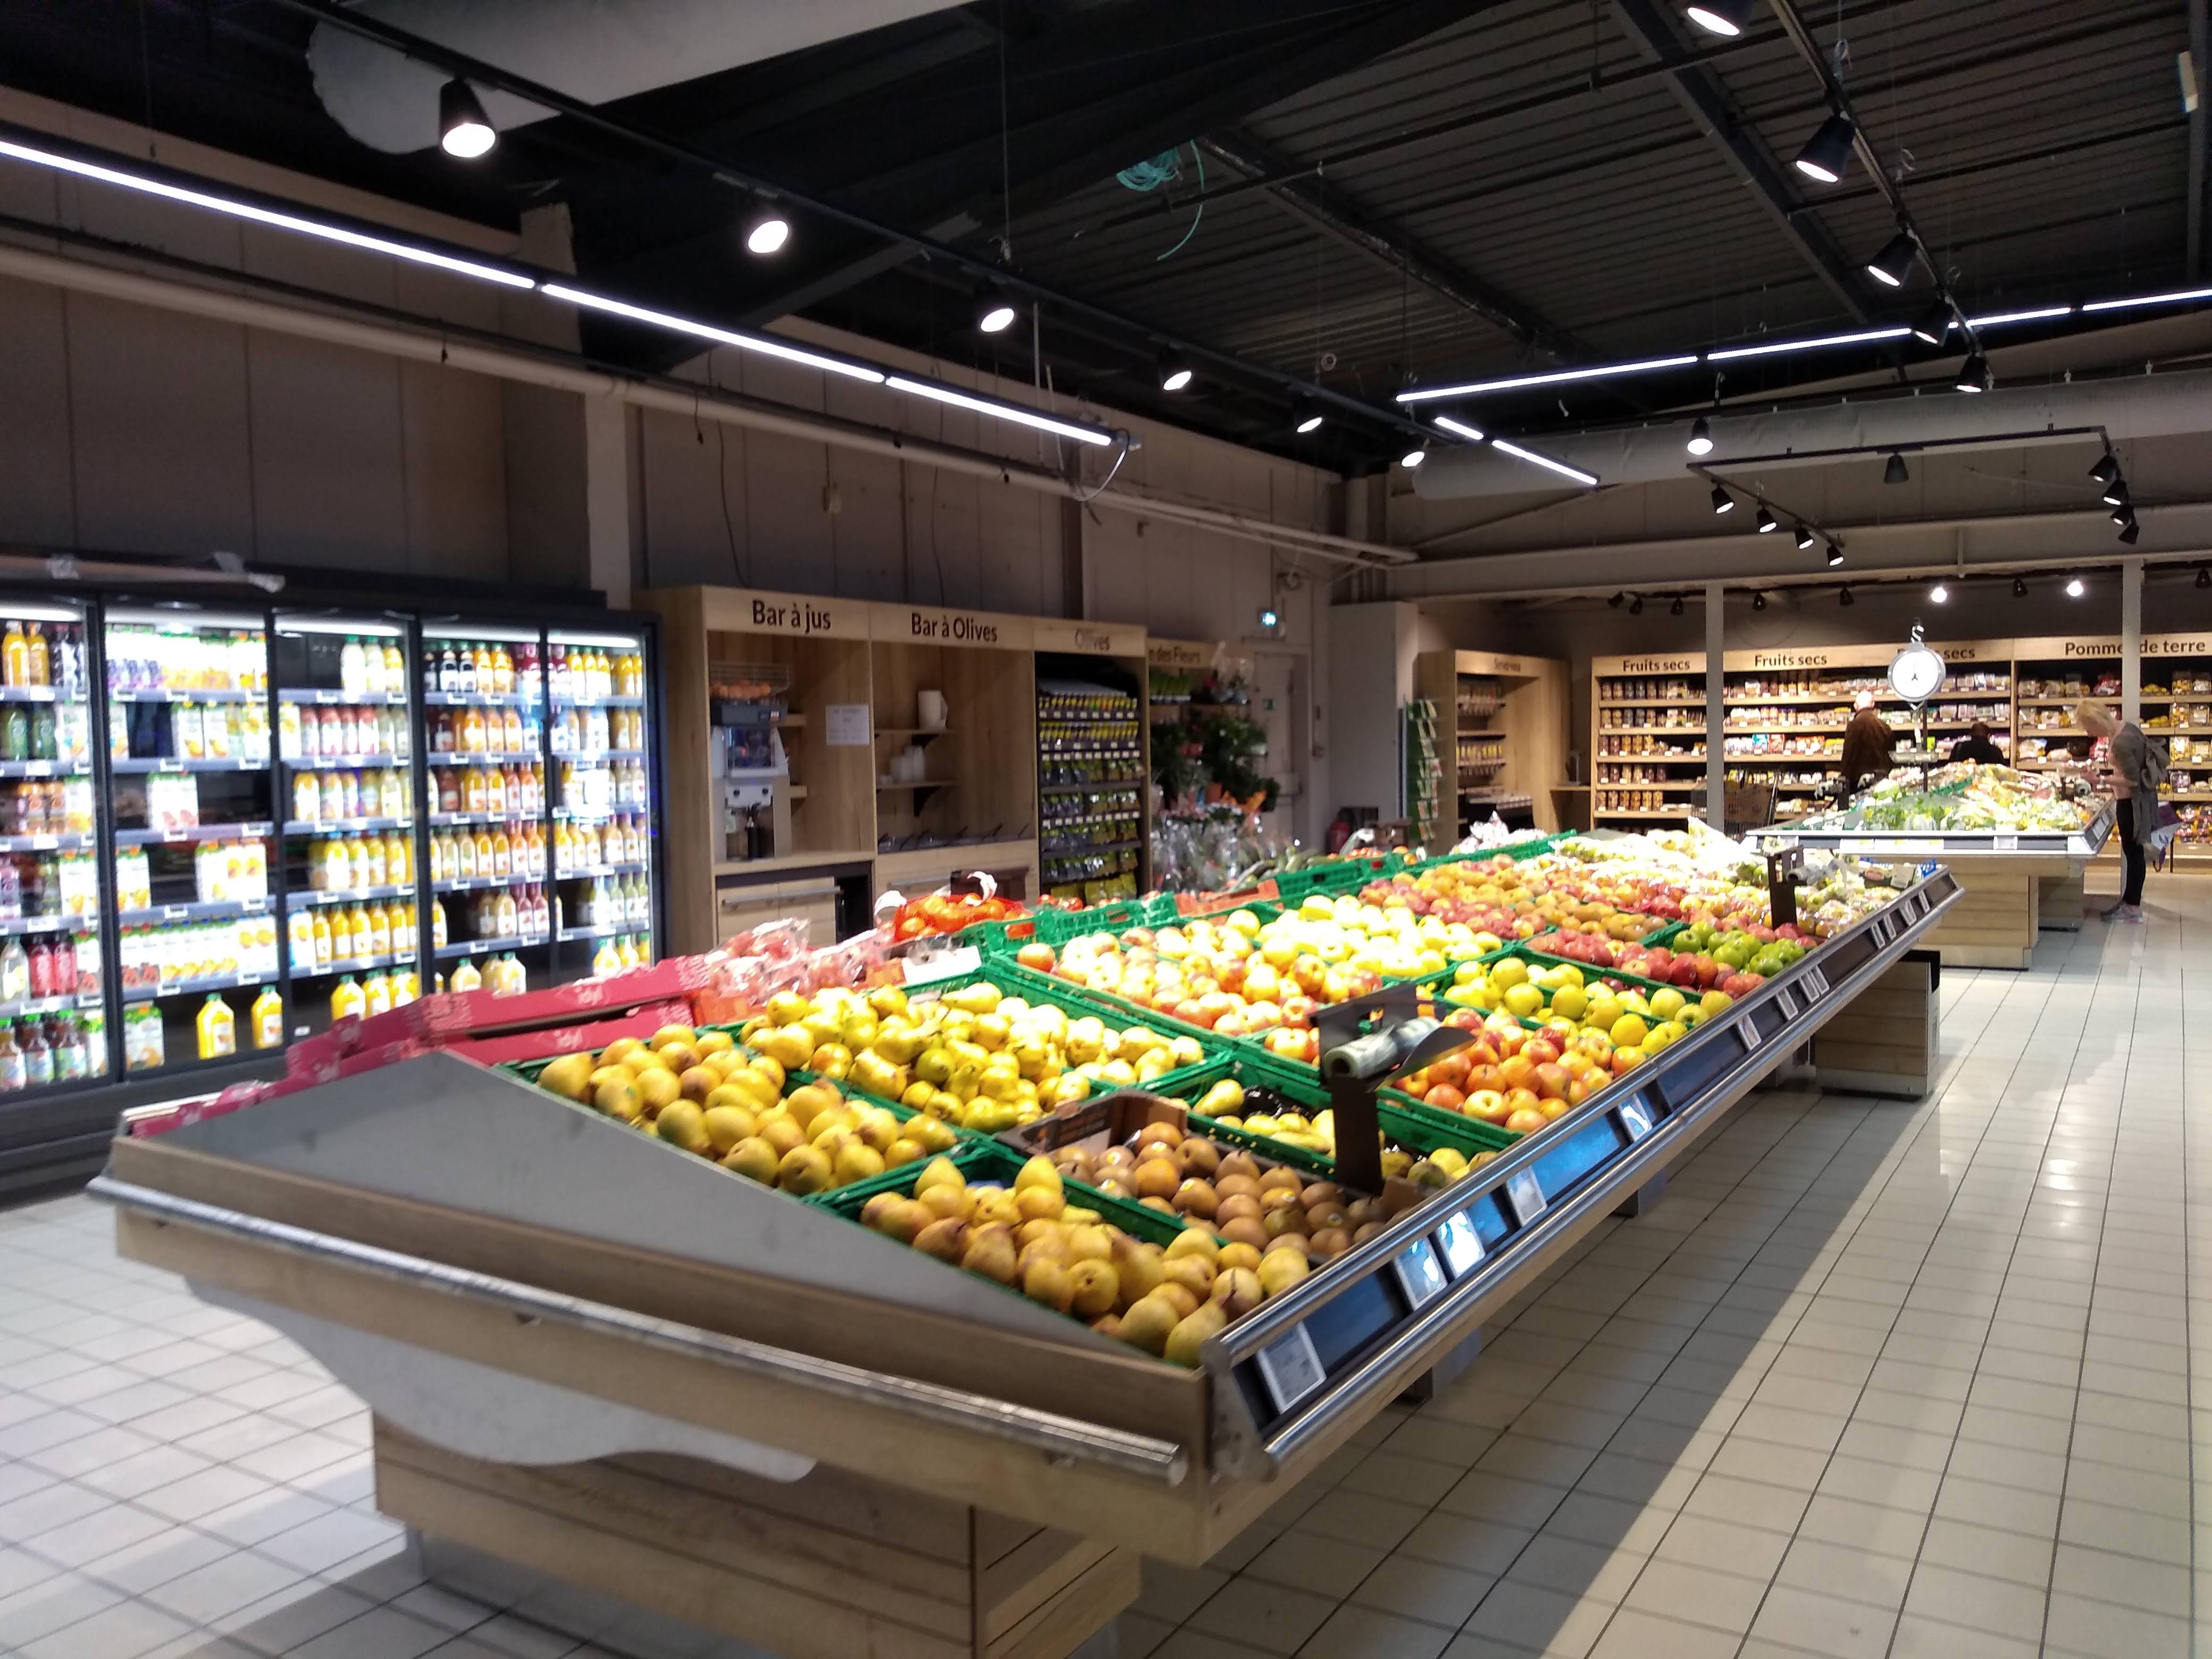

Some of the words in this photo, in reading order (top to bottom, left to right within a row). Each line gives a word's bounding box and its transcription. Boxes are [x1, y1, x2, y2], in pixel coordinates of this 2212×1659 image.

[752, 599, 785, 626] Bar
[791, 602, 800, 628] à
[805, 604, 831, 634] jus
[911, 613, 938, 636] Bar
[942, 615, 950, 639] à
[953, 617, 998, 642] Olives
[1943, 648, 1975, 659] secs
[2065, 642, 2123, 656] Pomme
[2140, 640, 2158, 653] de
[2164, 640, 2206, 653] terre
[1622, 658, 1660, 672] Fruits
[1663, 660, 1691, 671] secs
[1755, 653, 1794, 667] Fruits
[1798, 655, 1828, 666] secs
